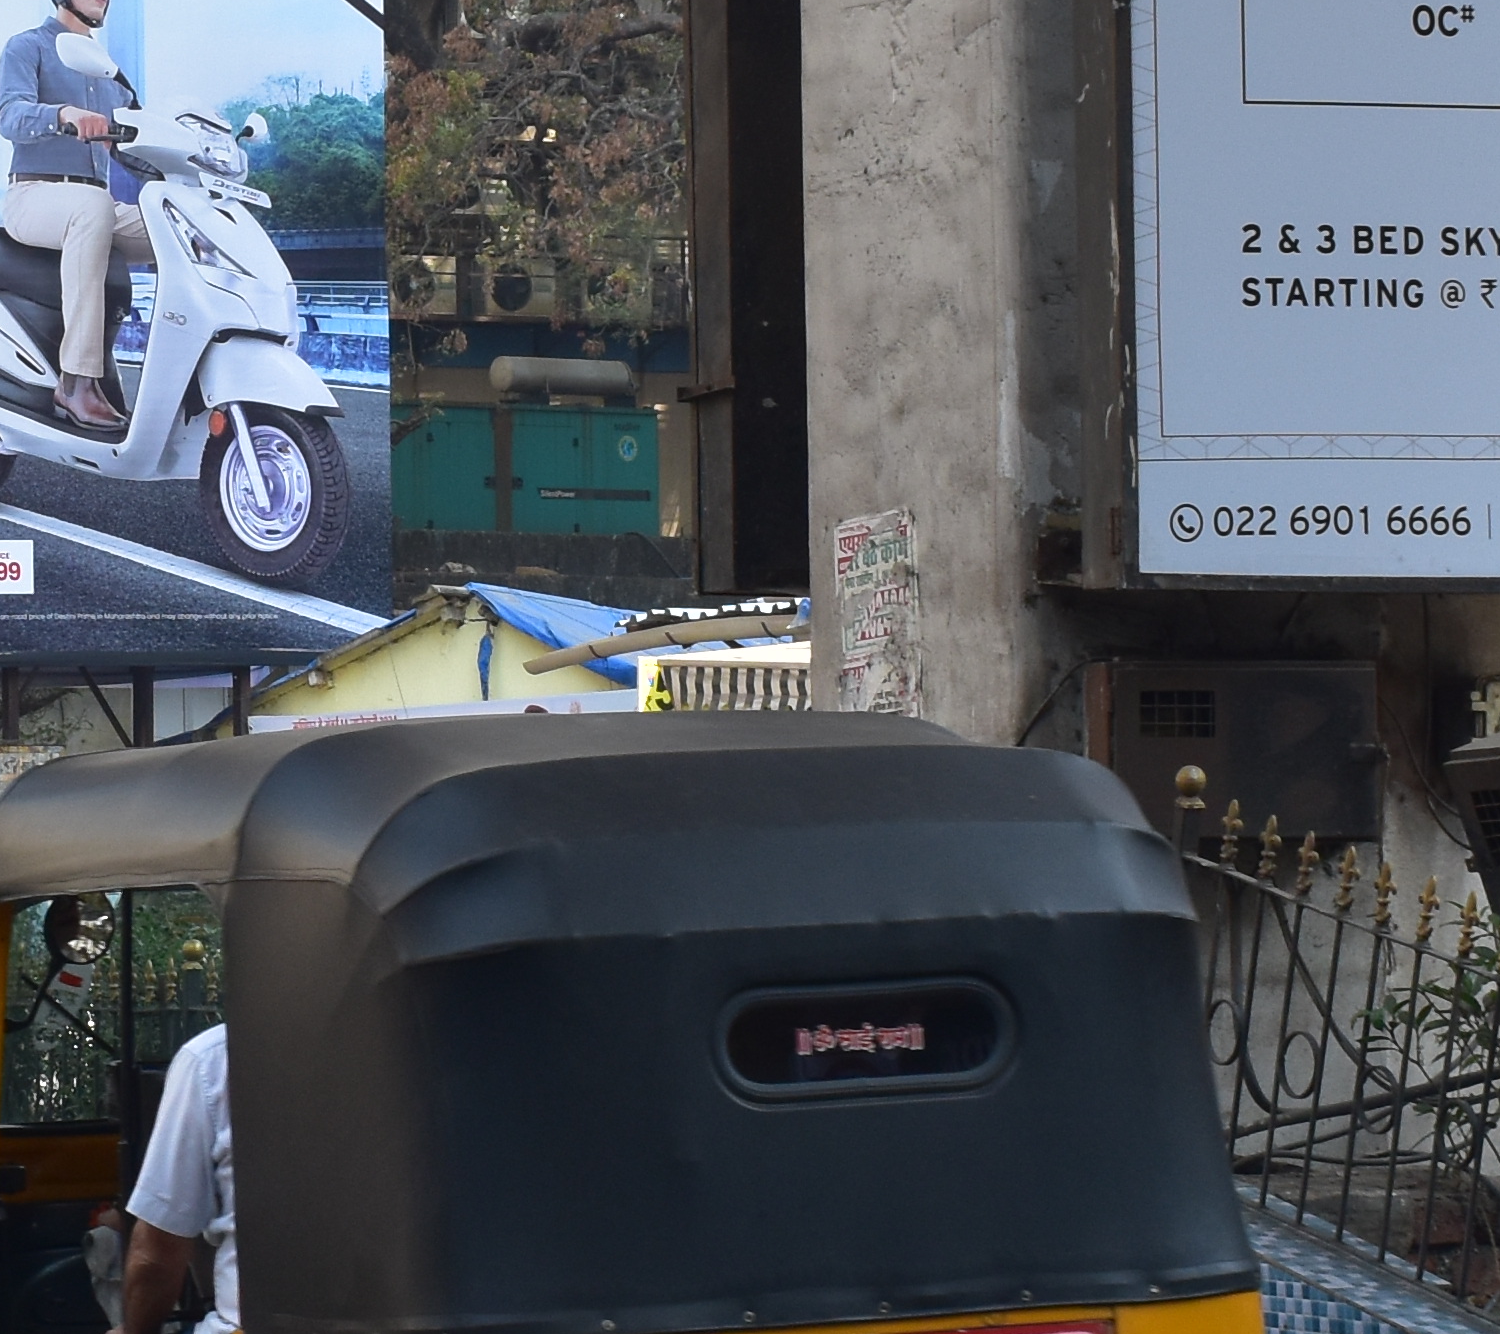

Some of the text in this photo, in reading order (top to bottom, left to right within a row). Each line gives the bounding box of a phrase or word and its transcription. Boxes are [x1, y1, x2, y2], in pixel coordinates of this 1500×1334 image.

[1413, 5, 1474, 36] OC#
[1242, 224, 1261, 253] 2
[1279, 224, 1300, 253] &
[1316, 225, 1335, 253] 3
[1354, 226, 1423, 254] BED
[1243, 278, 1423, 308] STARTING
[1441, 280, 1465, 308] @
[1214, 506, 1471, 536] 022 6901 6666
